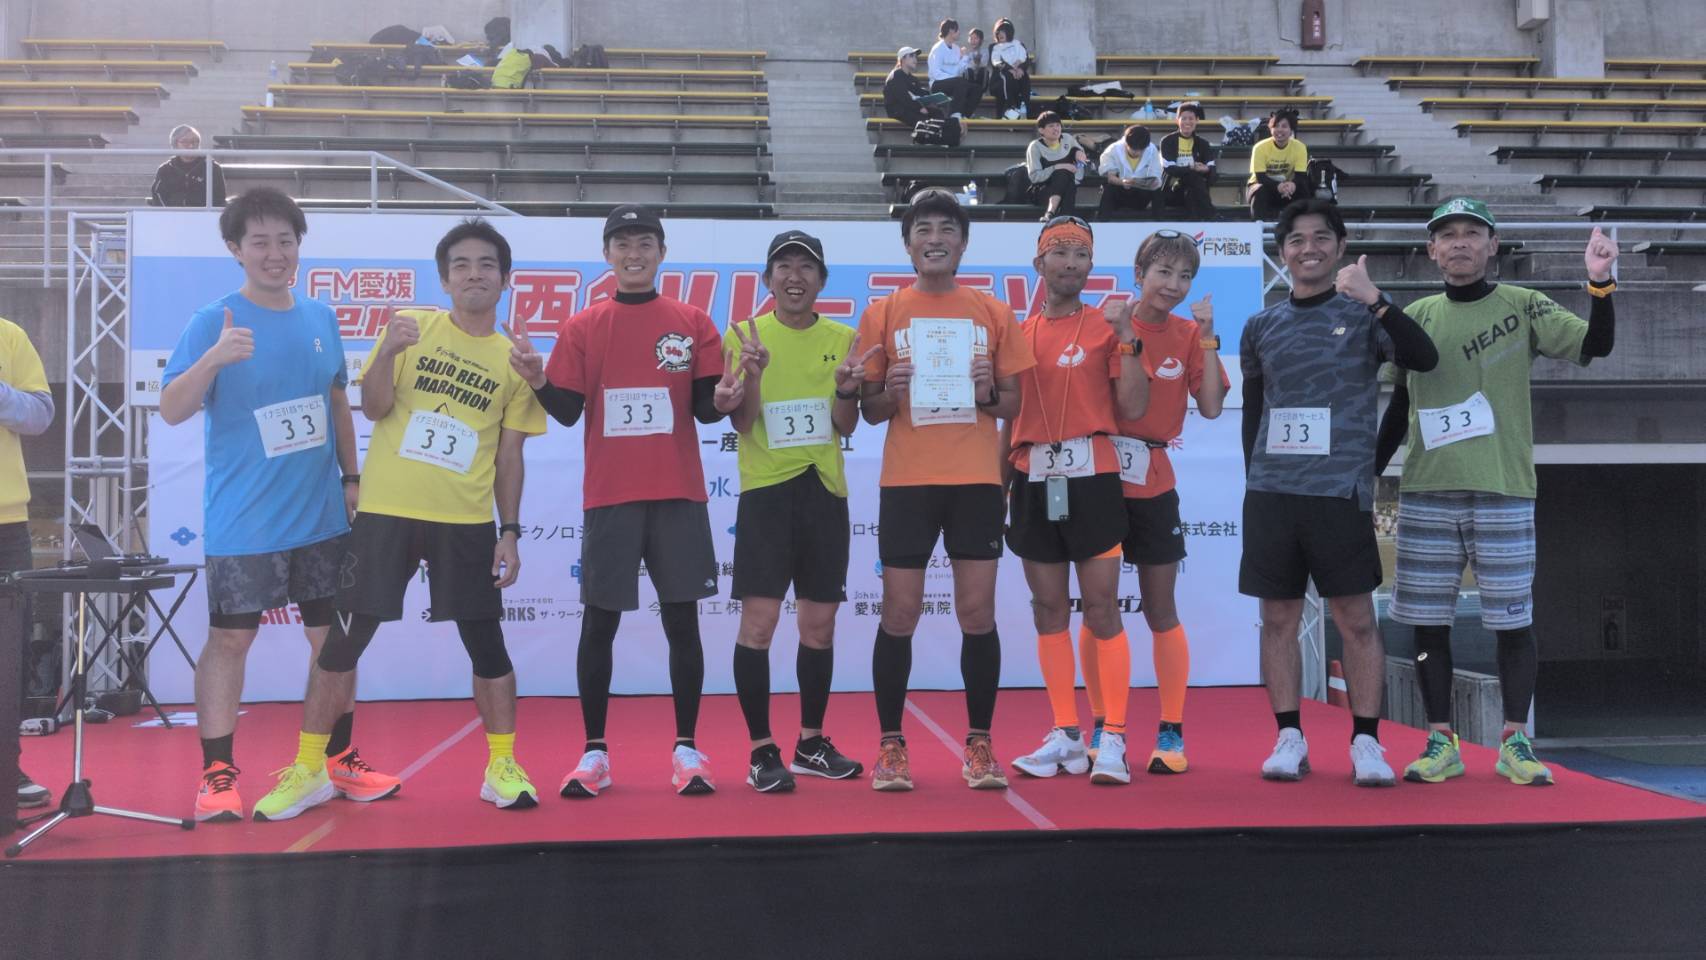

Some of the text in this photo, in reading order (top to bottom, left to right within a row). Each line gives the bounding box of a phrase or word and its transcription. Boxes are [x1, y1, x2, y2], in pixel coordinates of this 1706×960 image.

[1203, 242, 1251, 256] FM愛媛
[309, 271, 412, 299] FM愛媛
[1462, 314, 1520, 361] HEAD
[413, 375, 492, 413] MARATHON
[415, 355, 457, 378] SAIJO
[455, 368, 501, 395] RELAY
